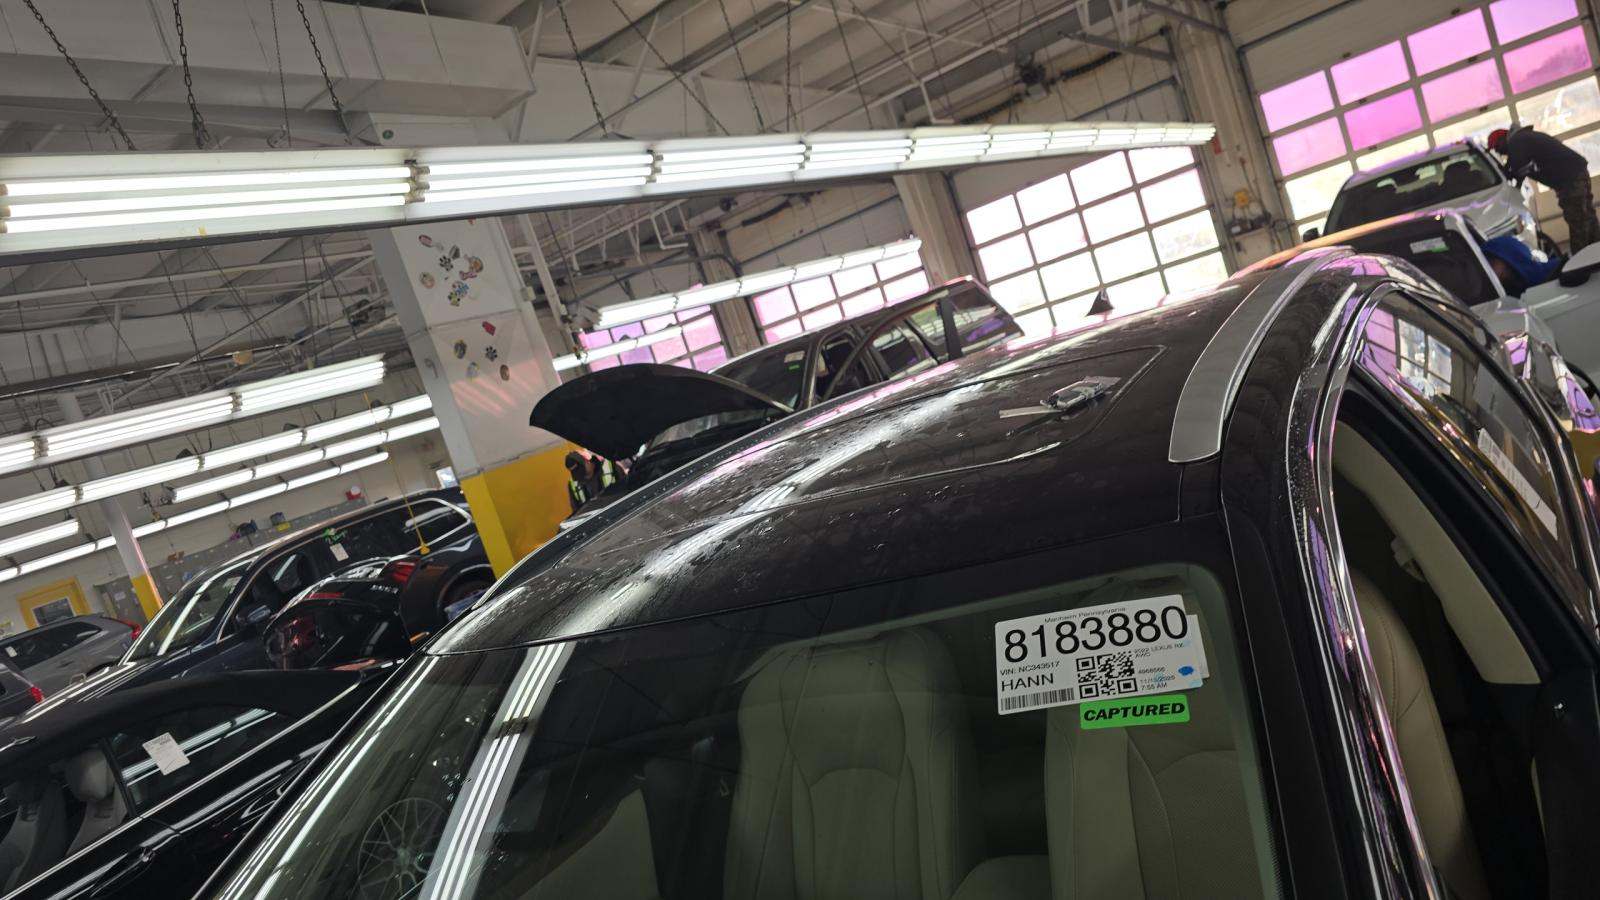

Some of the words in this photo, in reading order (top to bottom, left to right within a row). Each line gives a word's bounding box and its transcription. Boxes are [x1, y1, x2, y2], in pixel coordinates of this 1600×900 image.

[1004, 605, 1188, 663] 8183880
[999, 667, 1016, 676] VIN:
[1001, 672, 1054, 692] HANN
[1156, 681, 1168, 689] AM
[1083, 702, 1186, 722] CAPTURED
